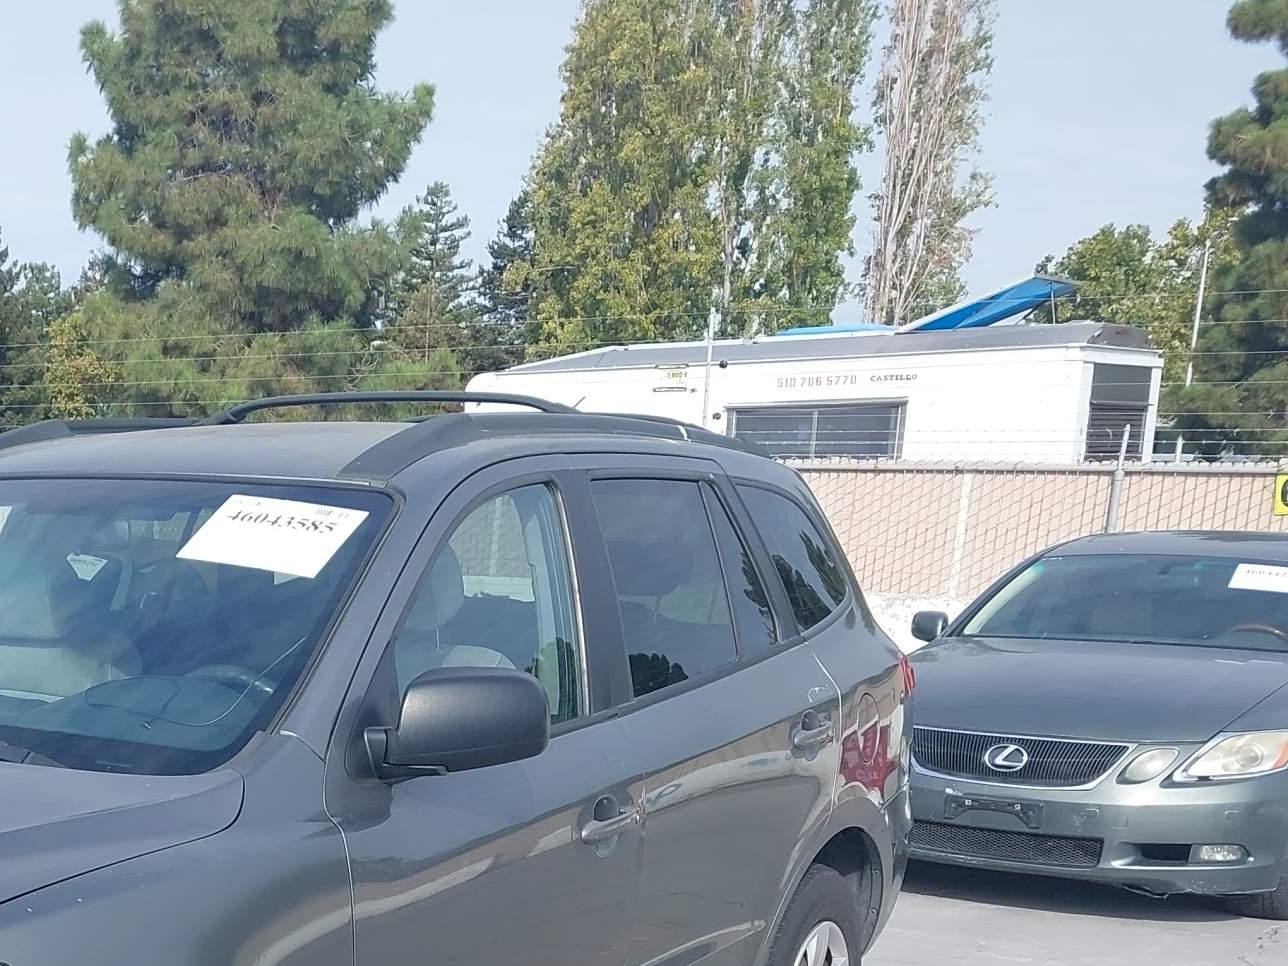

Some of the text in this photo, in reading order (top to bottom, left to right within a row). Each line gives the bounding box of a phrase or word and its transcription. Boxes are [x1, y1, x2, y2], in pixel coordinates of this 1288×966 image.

[777, 375, 857, 388] 510 706 5770
[870, 373, 918, 382] CASTILLO
[226, 510, 338, 533] 46043585
